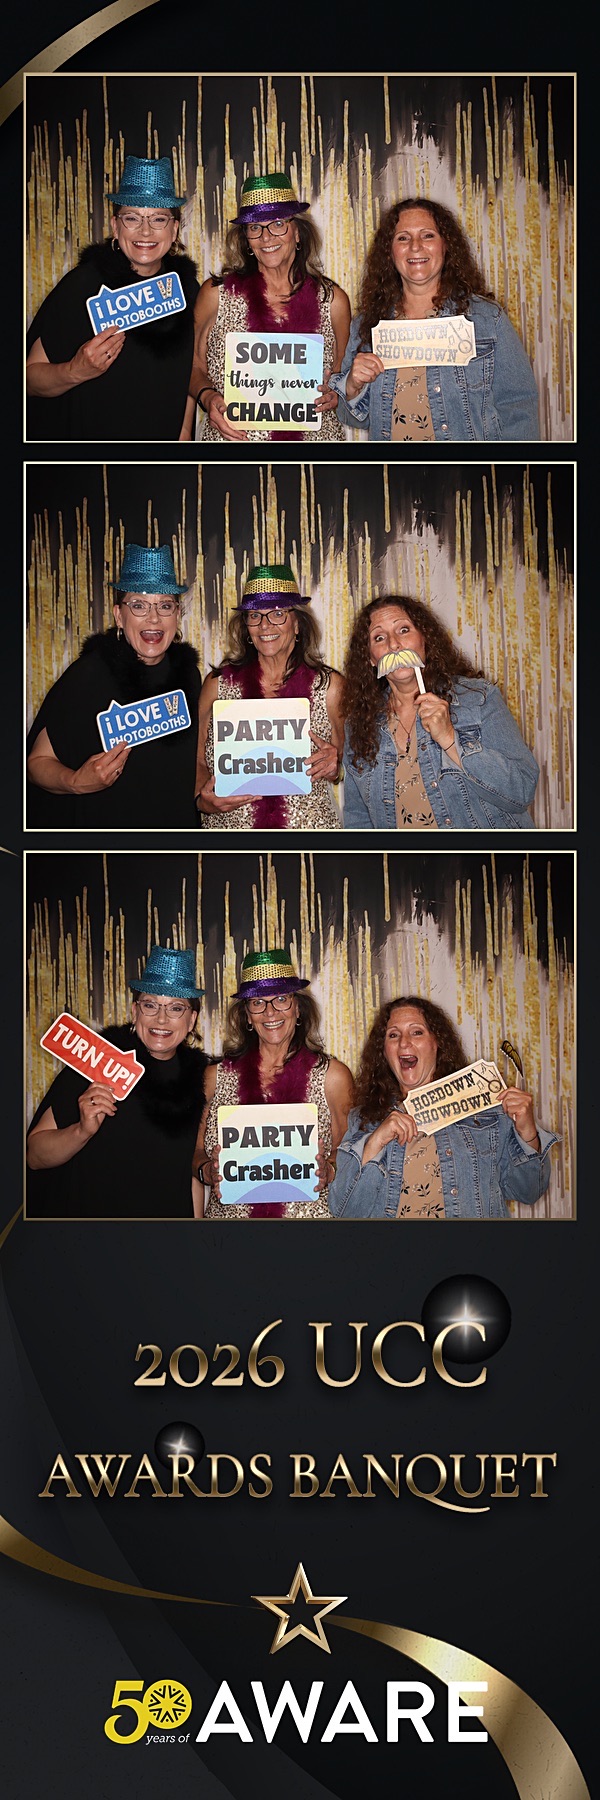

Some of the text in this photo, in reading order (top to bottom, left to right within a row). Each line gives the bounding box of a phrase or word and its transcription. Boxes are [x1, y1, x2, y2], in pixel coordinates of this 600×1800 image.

[105, 285, 155, 316] LOVE
[100, 297, 181, 331] PHOTOBOOTHS
[378, 324, 448, 343] HOEDOWN
[235, 342, 307, 364] SOME
[376, 344, 458, 363] SHOWDOWN
[226, 370, 319, 396] things never
[226, 402, 318, 422] CHANGE
[115, 702, 162, 731] LOVE
[109, 714, 187, 748] PHOTOBOOTHS
[217, 718, 307, 742] PARTY
[218, 752, 307, 775] Crasher
[52, 1023, 136, 1091] TURN UP!
[410, 1072, 476, 1112] HOEDOWN
[413, 1091, 492, 1126] SHOWDOWN
[222, 1124, 315, 1148] PARTY
[223, 1159, 315, 1182] Crasher
